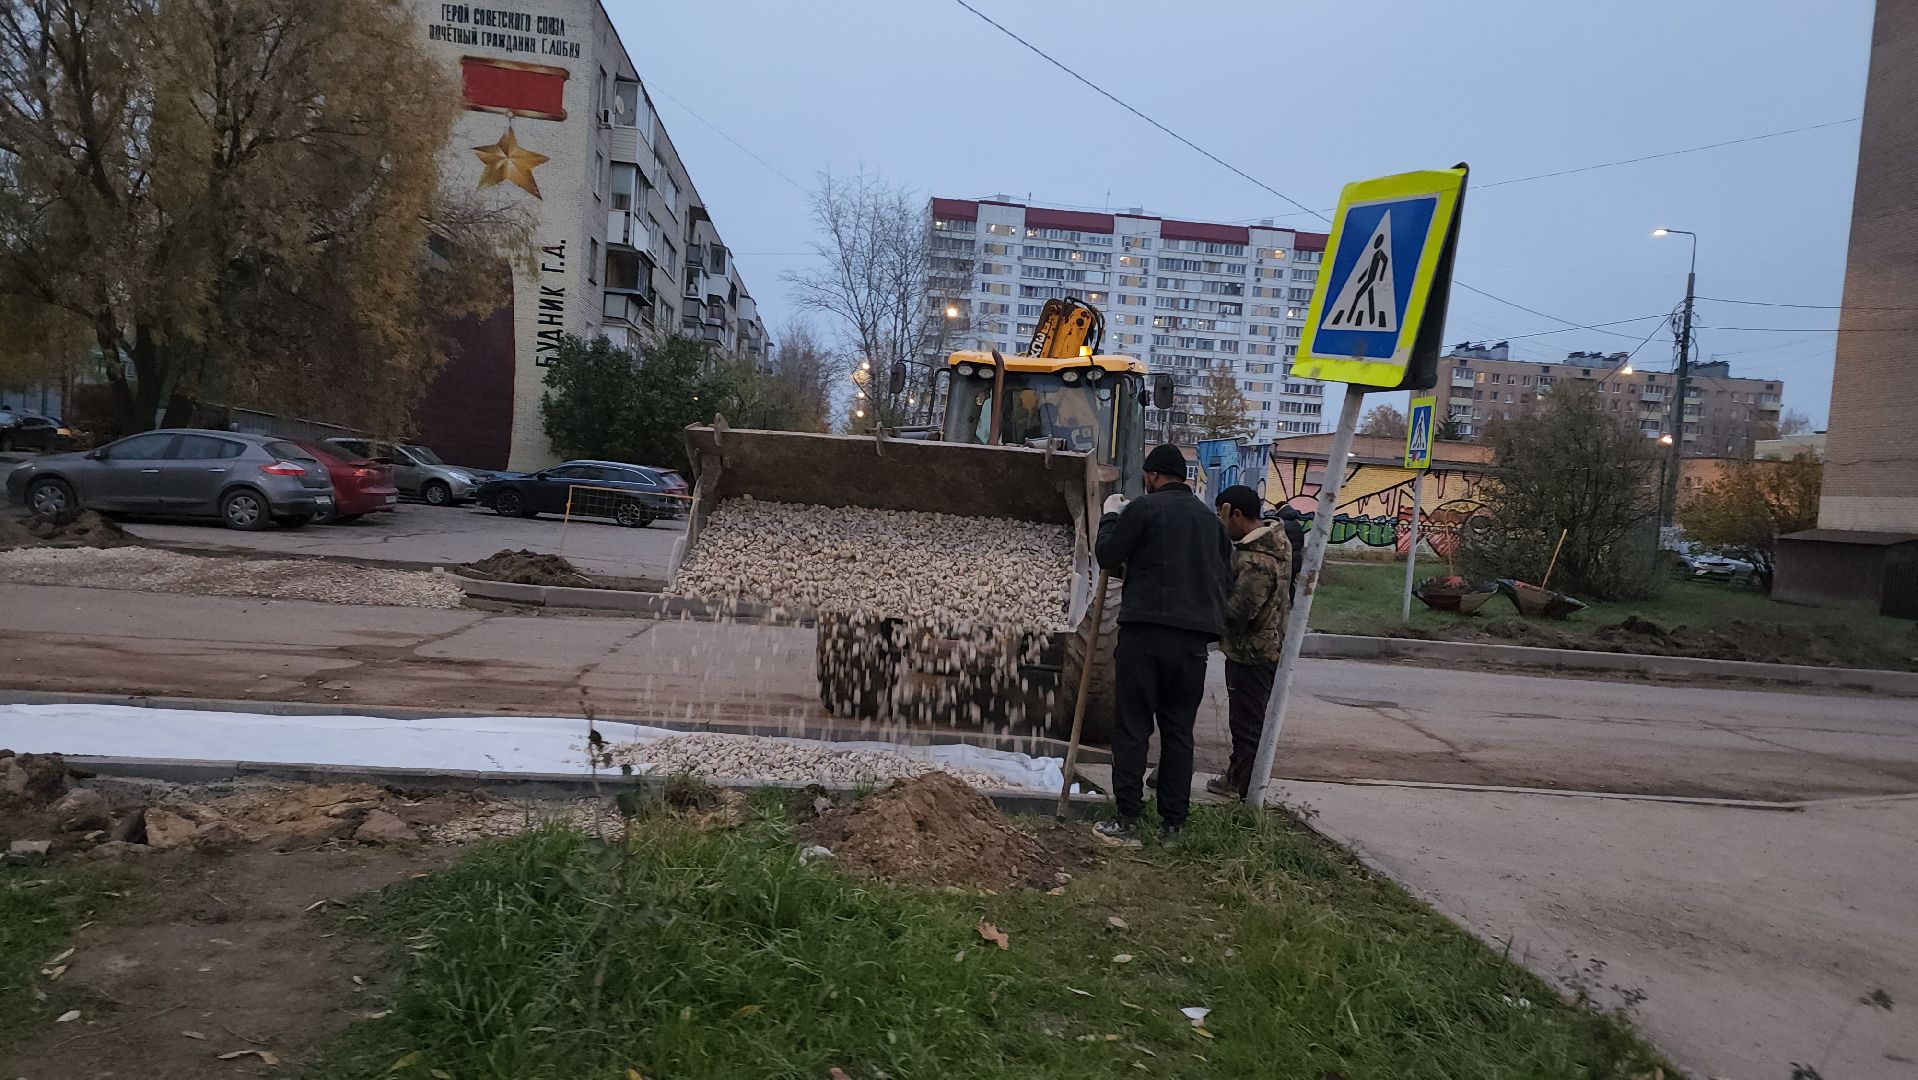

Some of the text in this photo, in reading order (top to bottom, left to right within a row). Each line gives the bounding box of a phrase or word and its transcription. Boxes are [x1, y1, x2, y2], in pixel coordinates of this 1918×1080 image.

[441, 4, 565, 36] ГЕРОЙ СОВЕТСКОГО СОЮЗА
[481, 31, 535, 53] ГРАЖДАНИН
[536, 240, 566, 367] БУДНИК Г.Д.
